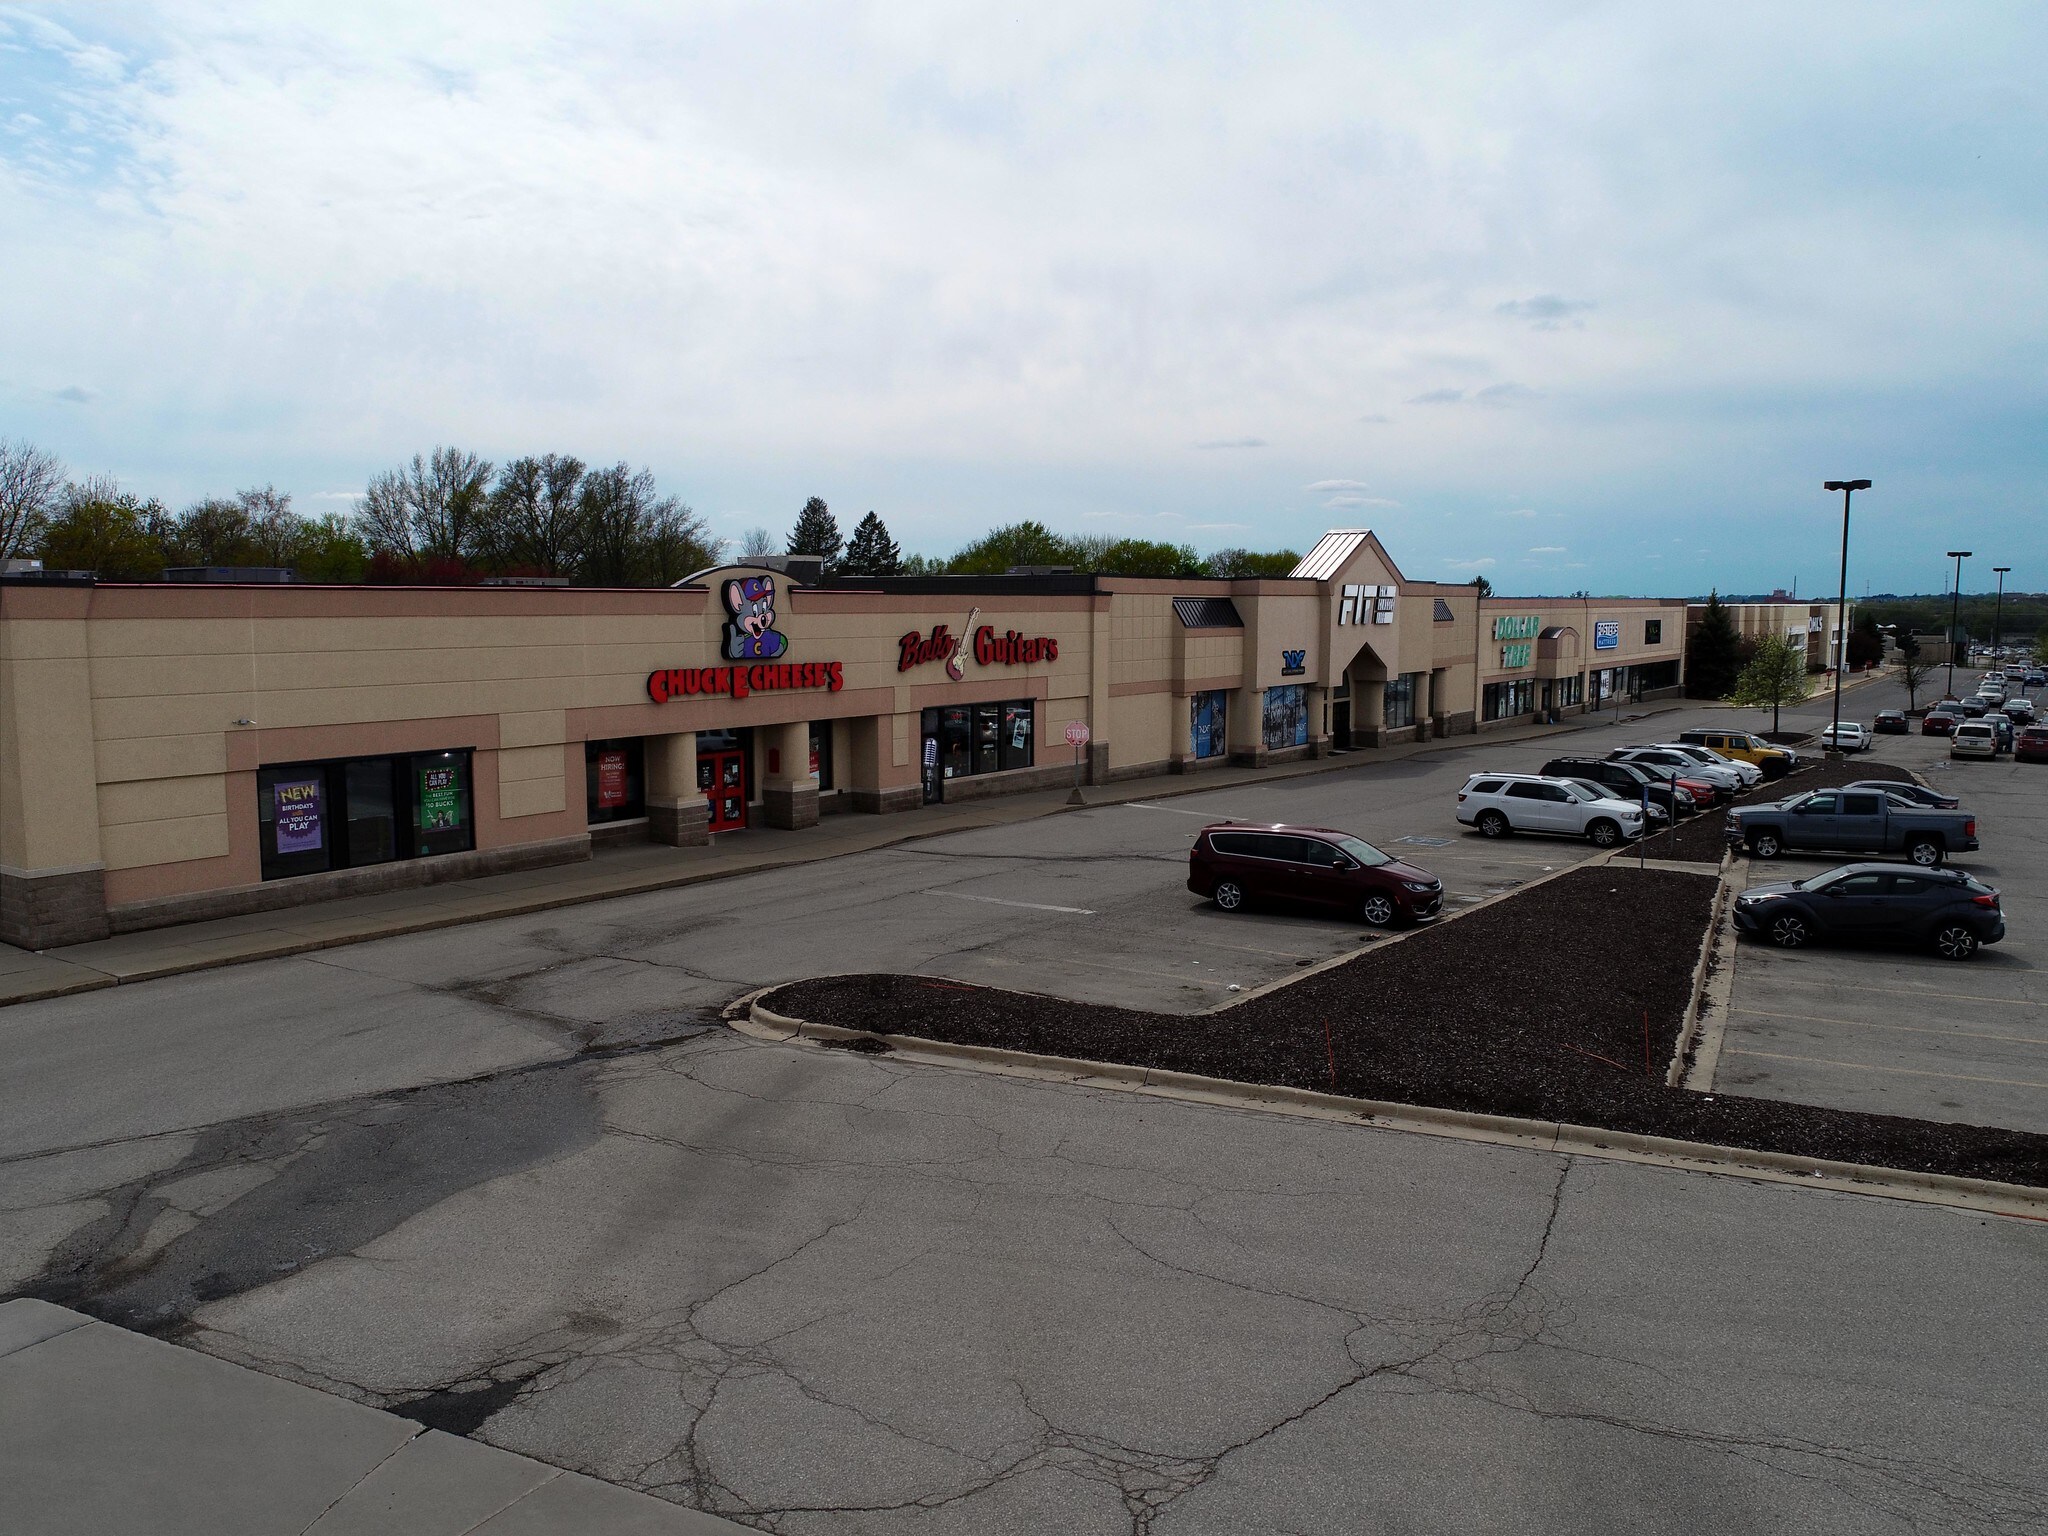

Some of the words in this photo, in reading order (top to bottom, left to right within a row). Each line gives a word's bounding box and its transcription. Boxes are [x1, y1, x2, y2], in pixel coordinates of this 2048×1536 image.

[753, 583, 758, 592] C
[1495, 616, 1539, 640] DOLLAR
[1598, 623, 1618, 635] FOSTERS
[754, 641, 762, 655] C
[898, 625, 956, 672] Bob's
[974, 625, 1058, 666] Guitars
[1503, 645, 1531, 668] TREE
[647, 667, 731, 704] CHUCK
[731, 666, 749, 699] E
[749, 662, 843, 692] CHEESE'S
[1066, 728, 1087, 740] STOP
[600, 762, 625, 771] HIRING!
[279, 785, 314, 803] NEW
[282, 803, 313, 811] BIRTHDAYS
[435, 800, 453, 808] BUCKS
[289, 822, 309, 831] PLAY
